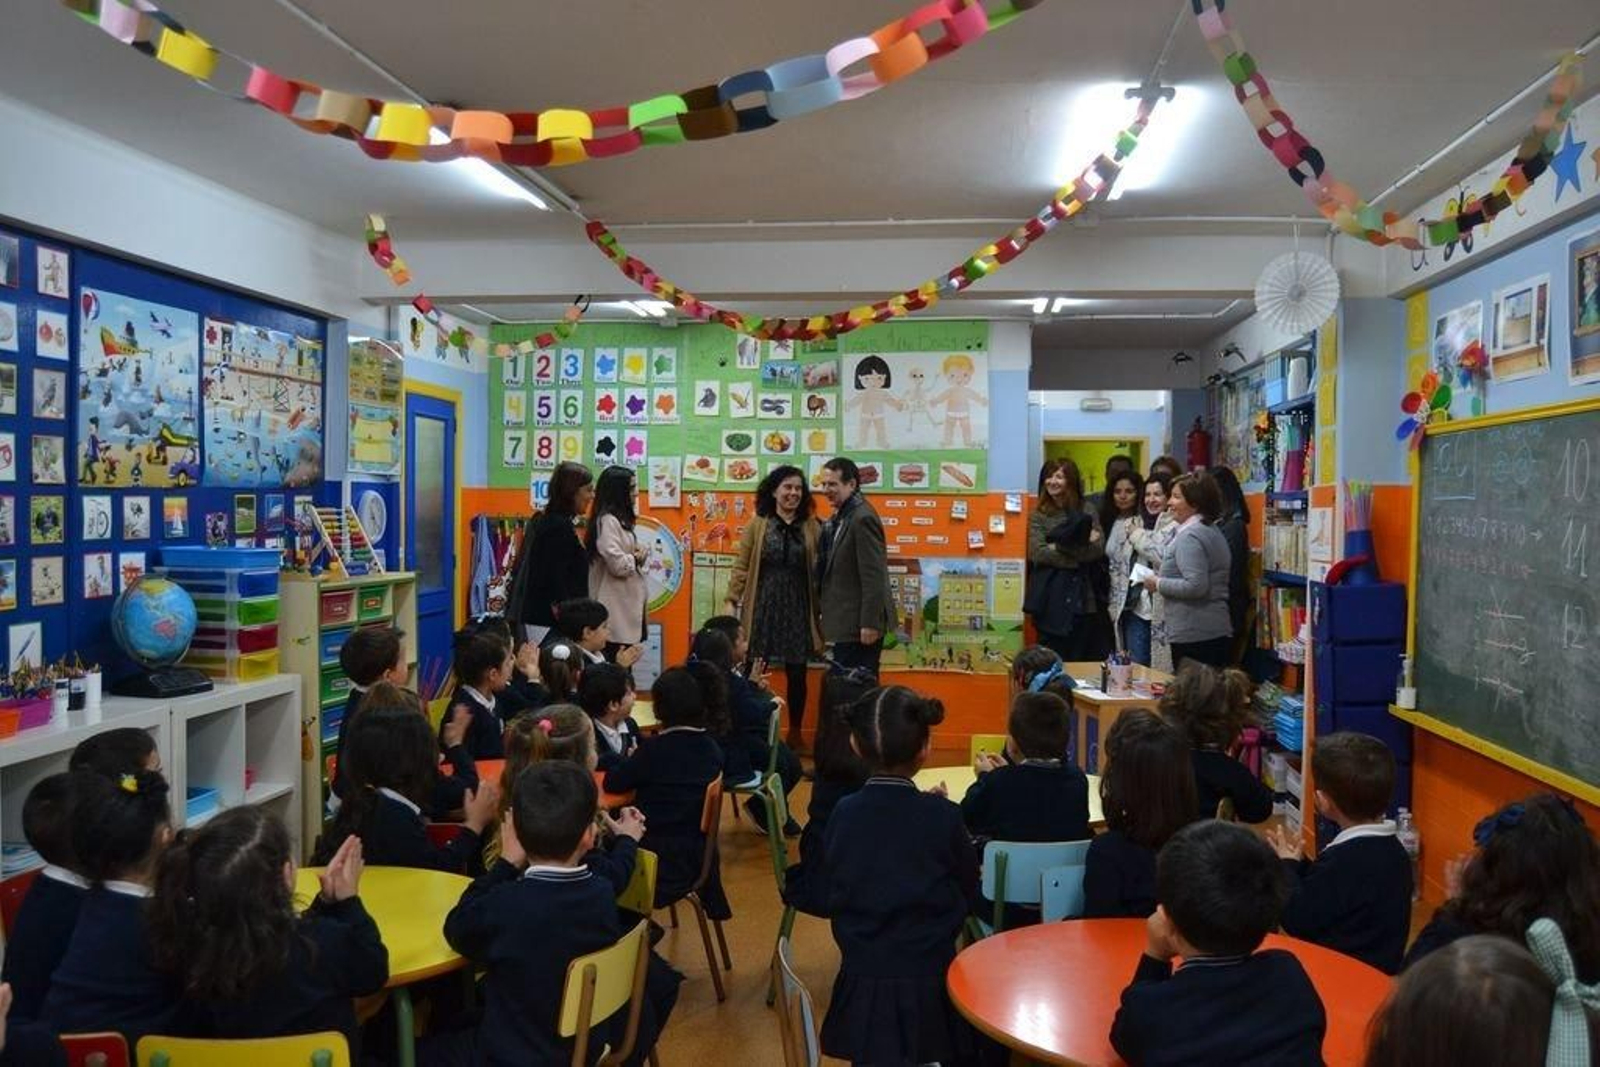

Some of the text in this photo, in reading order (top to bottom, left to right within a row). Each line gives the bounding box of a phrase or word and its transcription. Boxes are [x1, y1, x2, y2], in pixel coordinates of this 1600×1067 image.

[510, 355, 518, 378] 1
[537, 355, 551, 378] 2
[564, 354, 579, 377] 3
[508, 395, 523, 419] 4
[537, 396, 552, 419] 5
[563, 395, 579, 418] 6
[508, 436, 522, 459] 7
[537, 436, 552, 459] 8
[563, 435, 578, 459] 9
[1556, 437, 1590, 502] 10
[532, 480, 551, 499] 10
[1562, 514, 1589, 578] 11
[1562, 600, 1587, 649] 12
